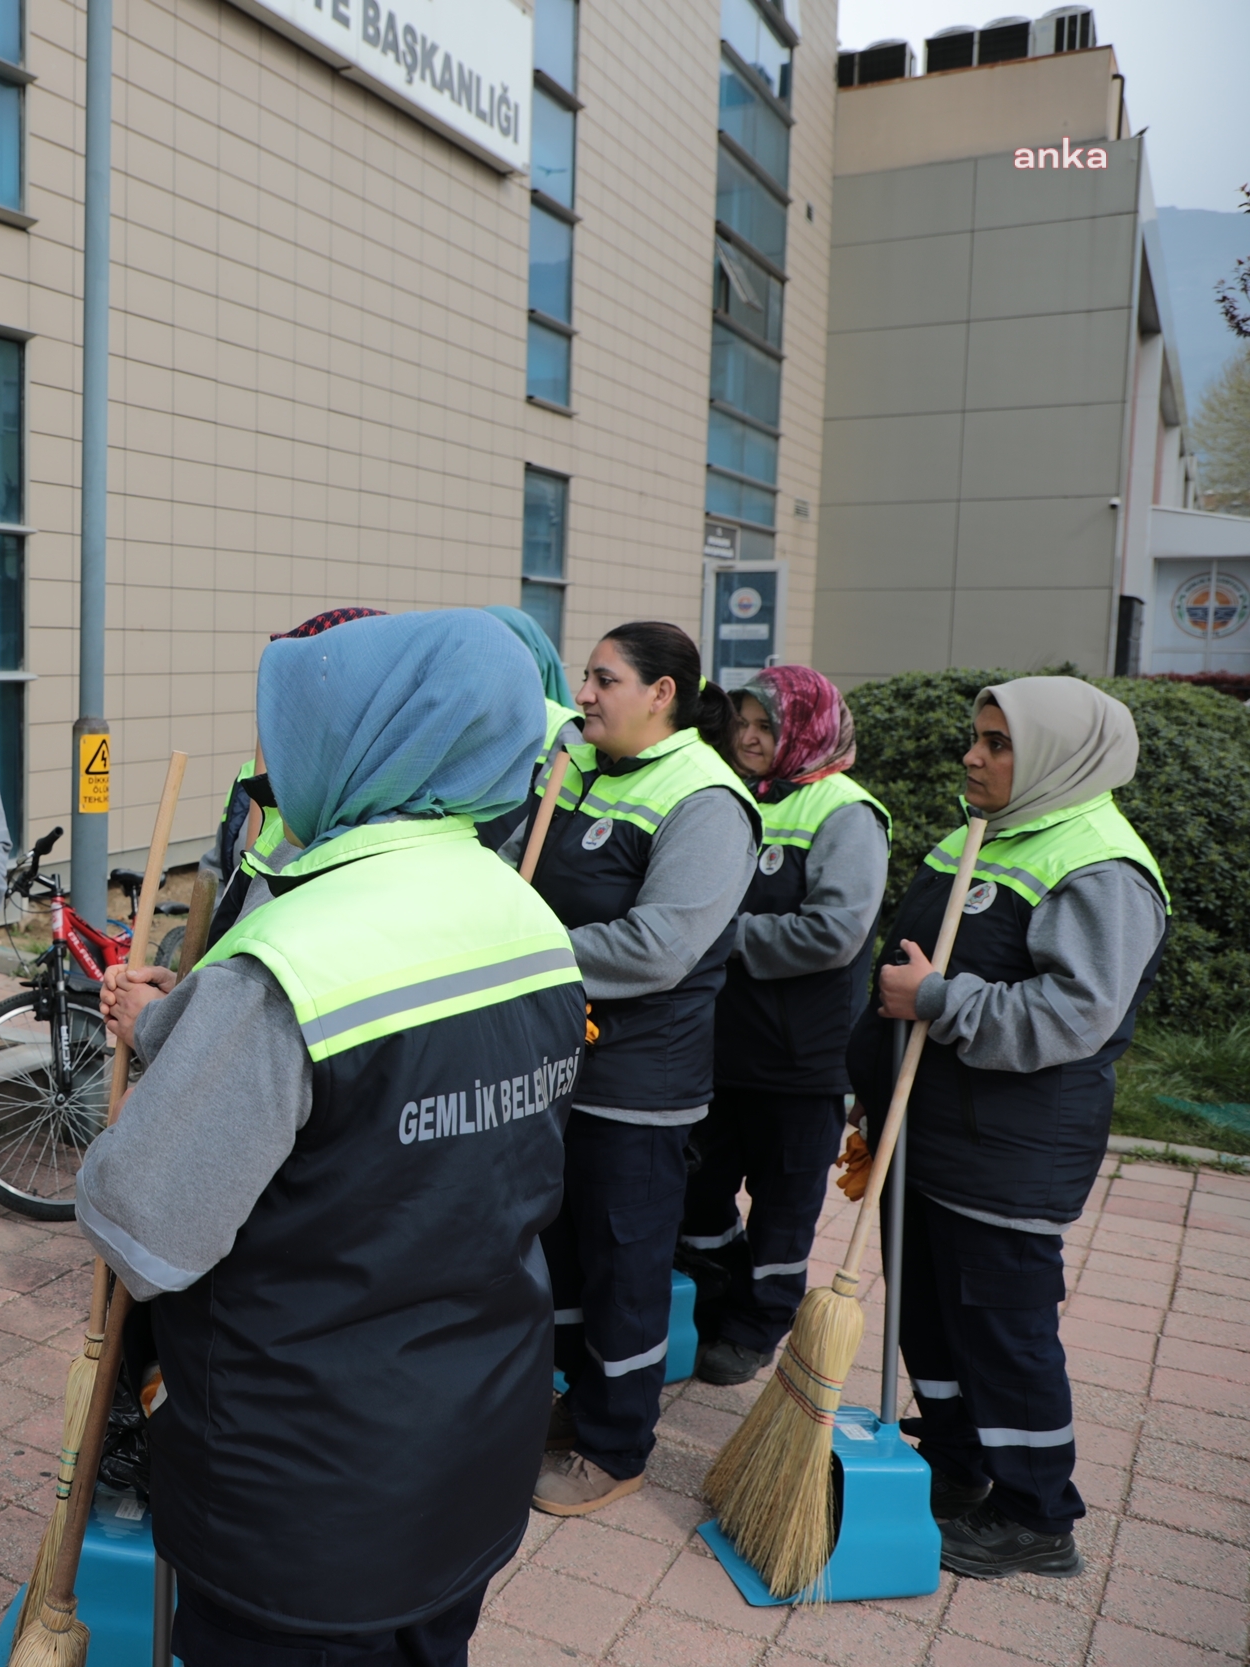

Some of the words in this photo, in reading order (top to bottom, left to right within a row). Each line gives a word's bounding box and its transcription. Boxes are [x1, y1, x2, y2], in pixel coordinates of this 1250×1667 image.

[361, 0, 520, 144] BAŞKANLIĞI
[398, 1079, 498, 1145] GEMLİK
[500, 1047, 581, 1124] BELEDİYESİ
